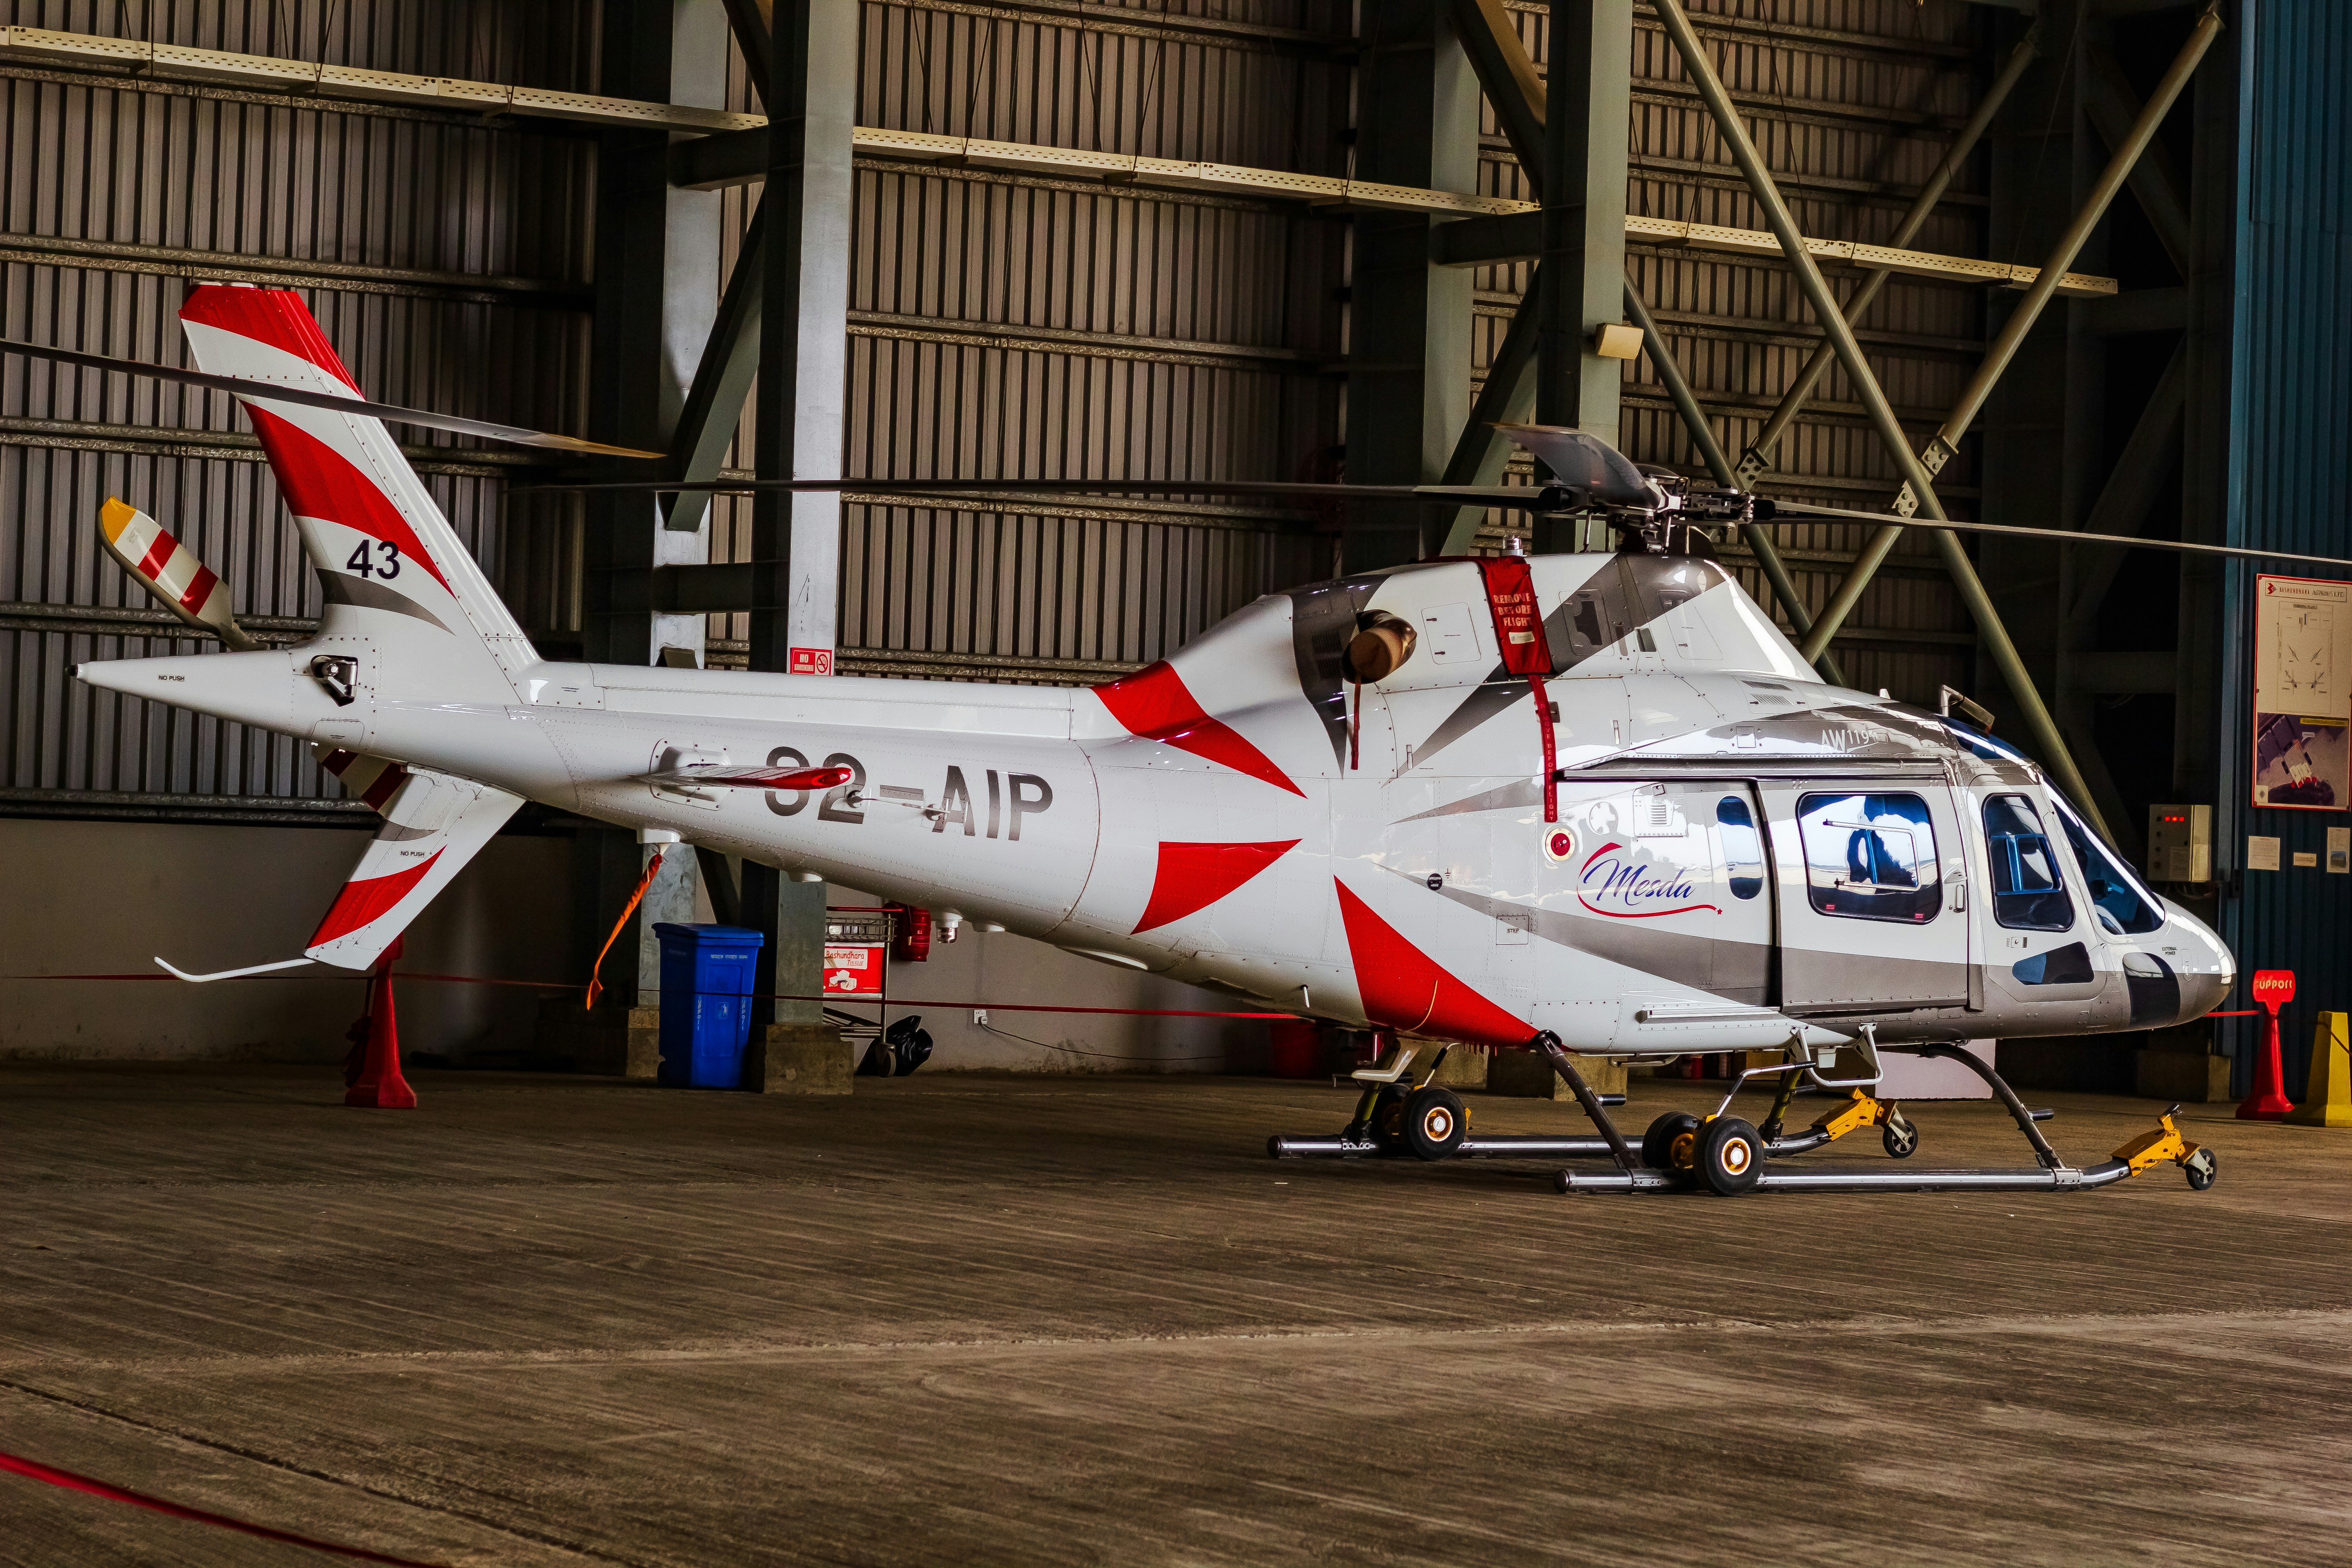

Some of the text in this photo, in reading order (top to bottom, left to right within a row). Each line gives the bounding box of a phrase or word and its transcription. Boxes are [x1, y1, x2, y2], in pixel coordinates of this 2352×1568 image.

[346, 539, 400, 580] 43
[1503, 617, 1533, 626] FLIGHT
[800, 654, 808, 663] NO
[1583, 858, 1697, 906] Mesda
[826, 950, 864, 959] Bashundhara
